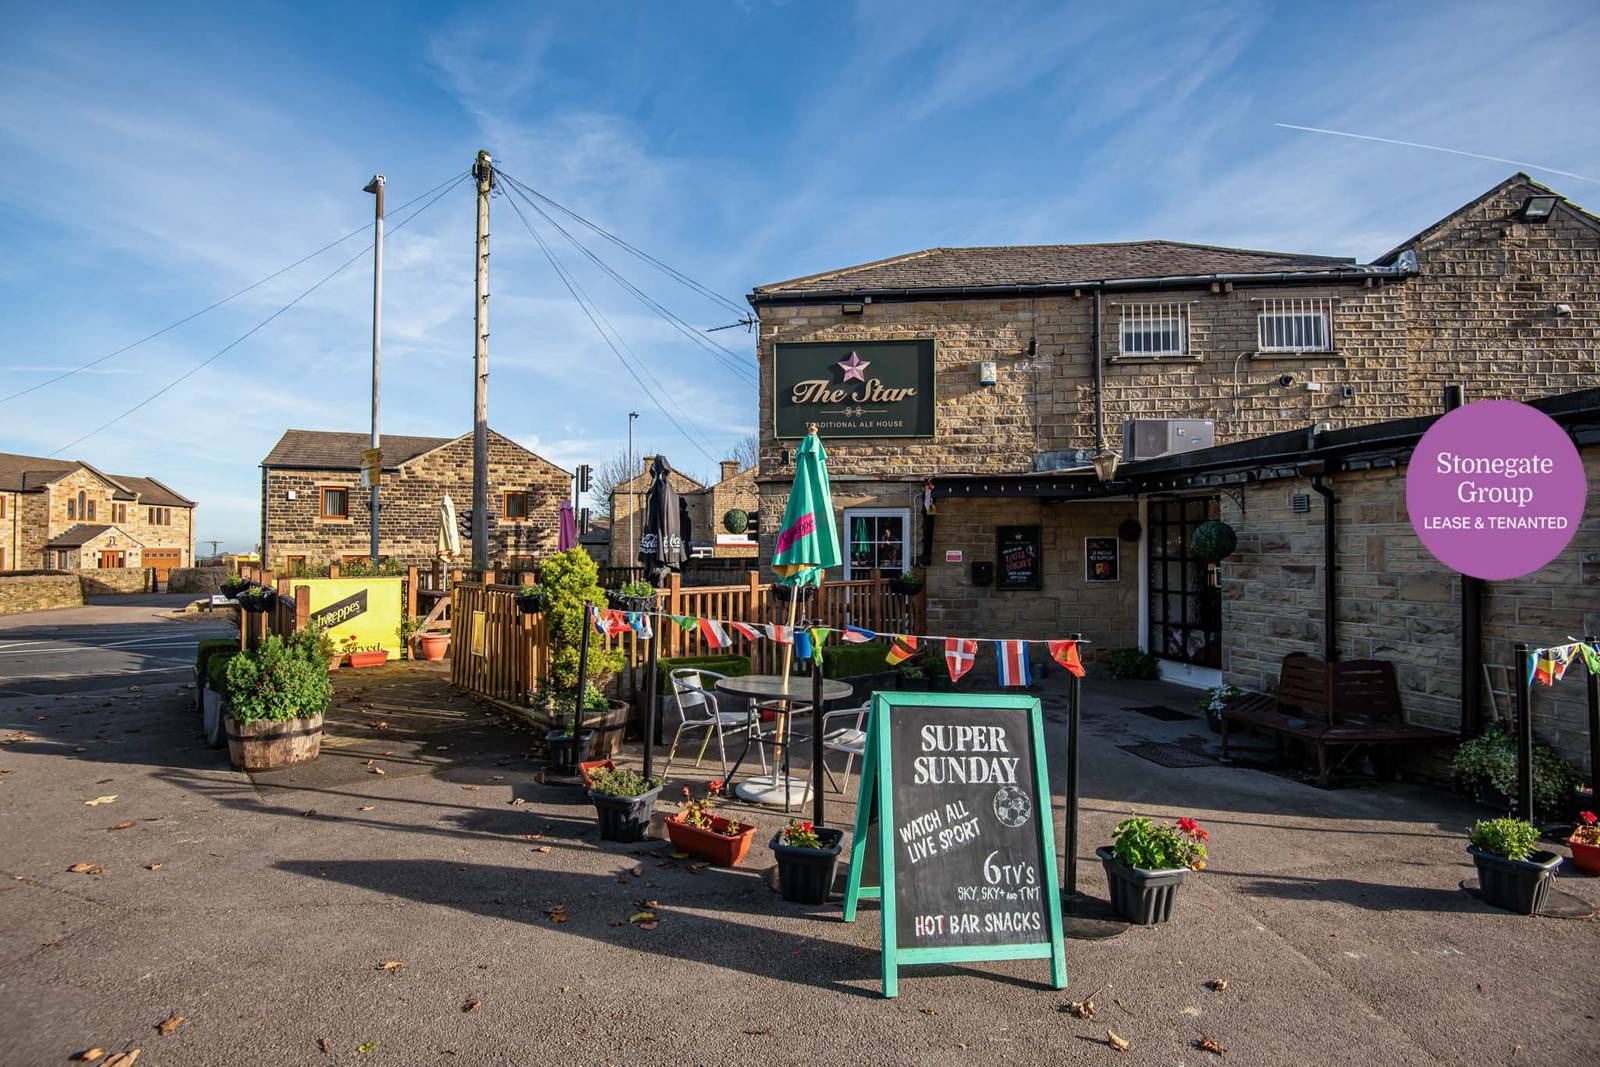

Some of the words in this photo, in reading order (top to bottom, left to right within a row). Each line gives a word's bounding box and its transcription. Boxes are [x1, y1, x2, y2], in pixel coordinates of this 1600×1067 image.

[791, 379, 847, 404] The
[852, 378, 918, 403] Star
[876, 420, 904, 428] HOUSE
[921, 724, 1009, 752] SUPER
[914, 756, 1020, 784] SUNDAY
[899, 809, 943, 843] WATCH
[945, 800, 970, 823] ALL
[907, 836, 938, 864] LIVE
[938, 817, 981, 850] SPORT
[1018, 886, 1041, 900] TNT
[914, 915, 945, 937] HOT
[950, 913, 981, 935] BAR
[984, 911, 1041, 933] SNACKS
